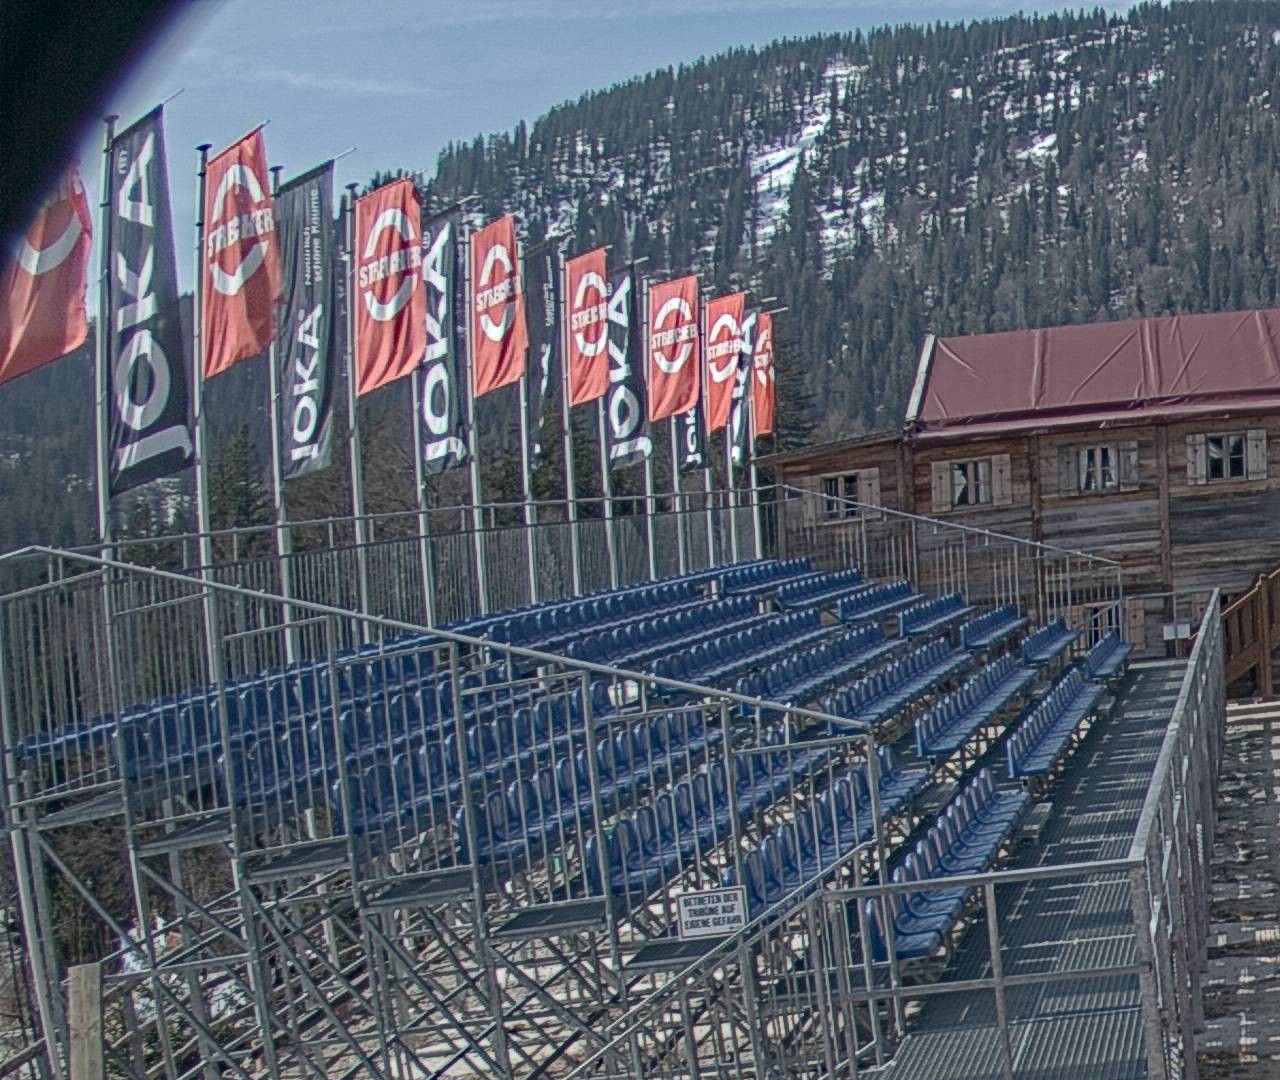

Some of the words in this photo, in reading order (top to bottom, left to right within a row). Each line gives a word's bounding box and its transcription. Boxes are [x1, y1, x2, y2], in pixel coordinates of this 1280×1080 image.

[290, 303, 323, 461] JOKA
[423, 222, 467, 462] JOKA
[608, 276, 653, 460] JOKA
